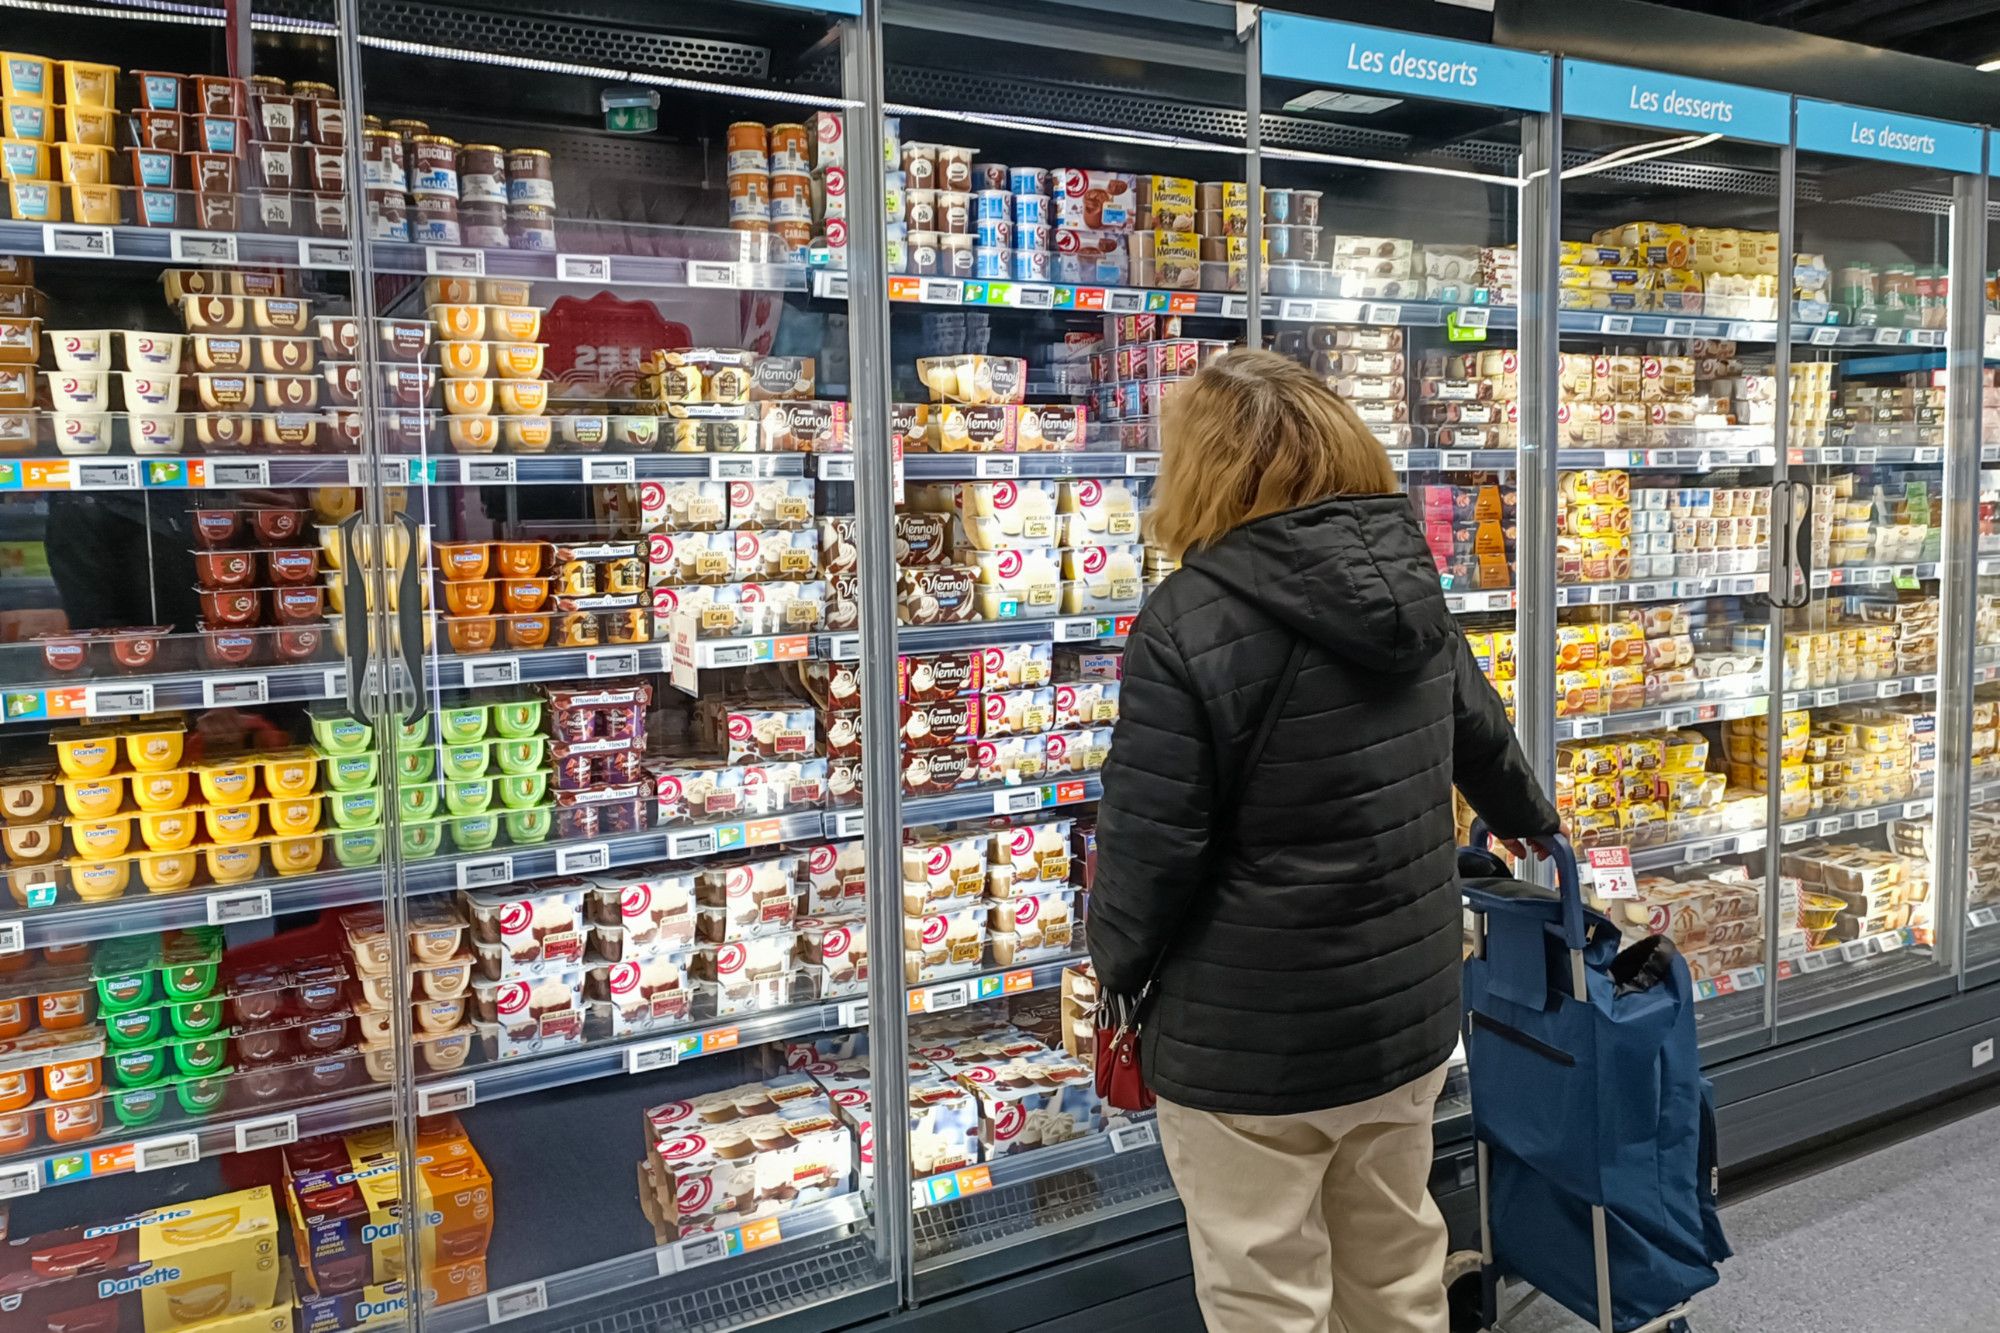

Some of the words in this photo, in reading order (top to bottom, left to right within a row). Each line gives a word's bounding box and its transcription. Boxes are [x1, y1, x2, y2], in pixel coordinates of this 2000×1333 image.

[1347, 42, 1384, 73] Les
[1389, 48, 1478, 87] desserts
[1629, 85, 1660, 112] Les
[1663, 89, 1733, 122] desserts
[1851, 121, 1876, 145] Les
[1878, 126, 1935, 155] desserts
[751, 362, 803, 382] Viennois
[782, 408, 833, 427] Viennois
[964, 411, 1004, 429] Viennois
[1039, 412, 1077, 430] Viennois
[897, 515, 941, 535] Viennois
[921, 575, 971, 594] Viennois
[1084, 659, 1113, 667] Danette
[931, 661, 970, 680] Viennois
[926, 708, 967, 727] Viennois
[335, 725, 364, 735] Danette
[73, 746, 107, 757] Danette
[340, 762, 369, 771] Danette
[926, 756, 968, 773] Viennois
[215, 774, 246, 784] Danette
[77, 786, 110, 796] Danette
[345, 800, 374, 809] Danette
[218, 812, 249, 822] Danette
[85, 828, 119, 837] Danette
[344, 838, 373, 846] Danette
[218, 853, 249, 861] Danette
[1594, 850, 1611, 858] PRIX
[1612, 849, 1622, 857] EN
[1595, 856, 1625, 866] BAISSE
[84, 869, 116, 878] Danette
[545, 940, 578, 953] Chocolat
[108, 977, 141, 990] Danette
[431, 1005, 458, 1015] Danette
[117, 1014, 149, 1027] Danette
[938, 1154, 963, 1166] LIÉGEOIS
[84, 1208, 193, 1240] Danette
[315, 1246, 346, 1258] FAMILIAL
[316, 1240, 344, 1252] FORMAT
[98, 1265, 181, 1299] Danette
